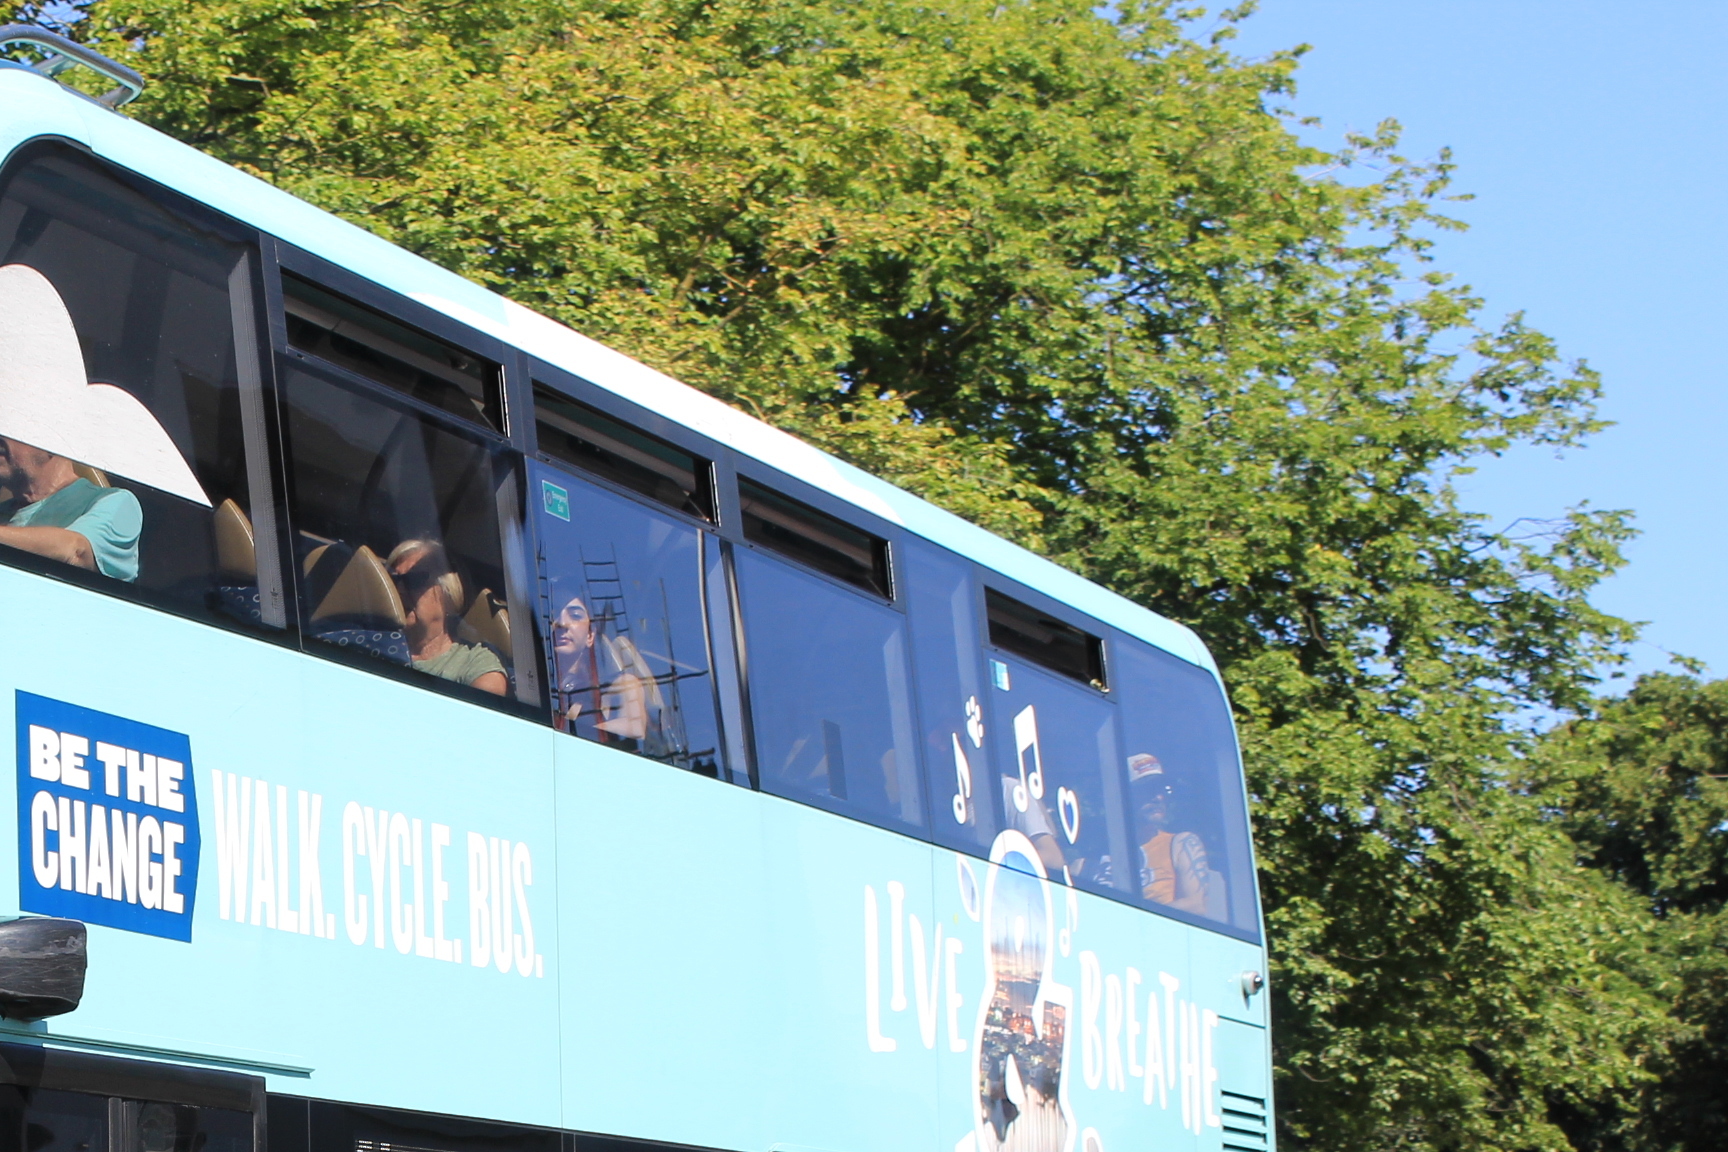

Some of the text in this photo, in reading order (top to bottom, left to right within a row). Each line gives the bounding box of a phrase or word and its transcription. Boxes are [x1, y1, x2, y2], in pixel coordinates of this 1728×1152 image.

[29, 724, 185, 813] BE THE
[30, 790, 185, 914] CHANGE
[211, 768, 543, 978] WALK. CYCLE. BUS.
[864, 880, 967, 1053] LIVE
[1079, 949, 1220, 1136] BREATHE
